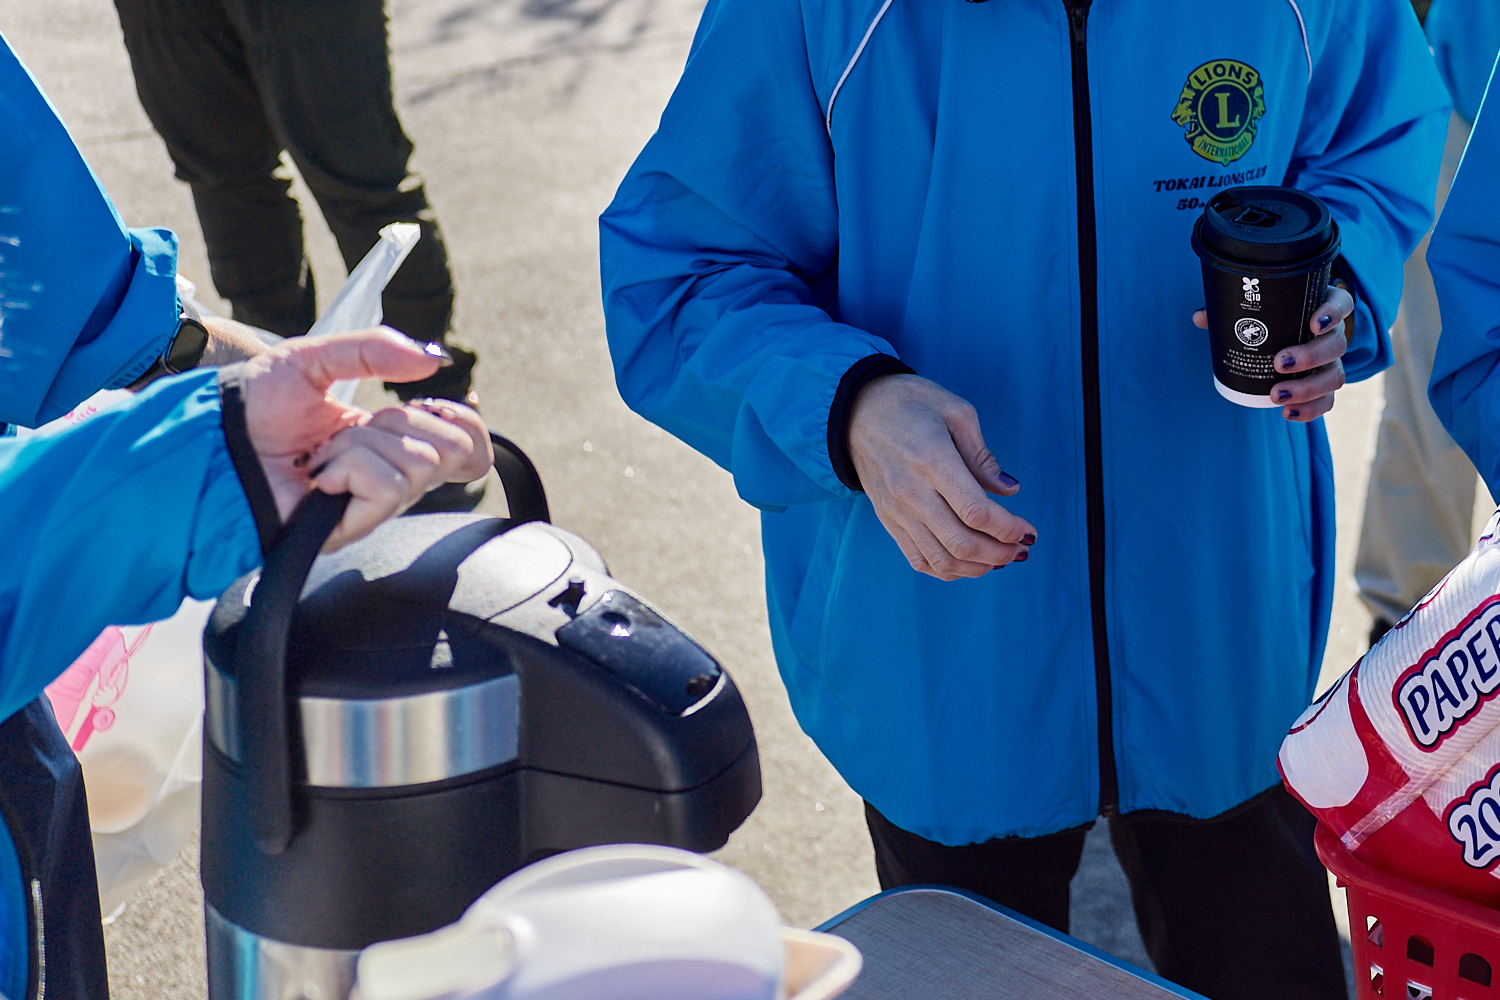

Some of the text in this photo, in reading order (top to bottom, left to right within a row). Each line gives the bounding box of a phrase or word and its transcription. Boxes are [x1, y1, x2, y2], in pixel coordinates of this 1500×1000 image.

[1193, 63, 1255, 86] LIONS
[1214, 92, 1241, 129] L
[1197, 136, 1250, 158] INTERNATIONAL
[1153, 176, 1206, 193] TOKAI
[1206, 173, 1246, 188] LIONS
